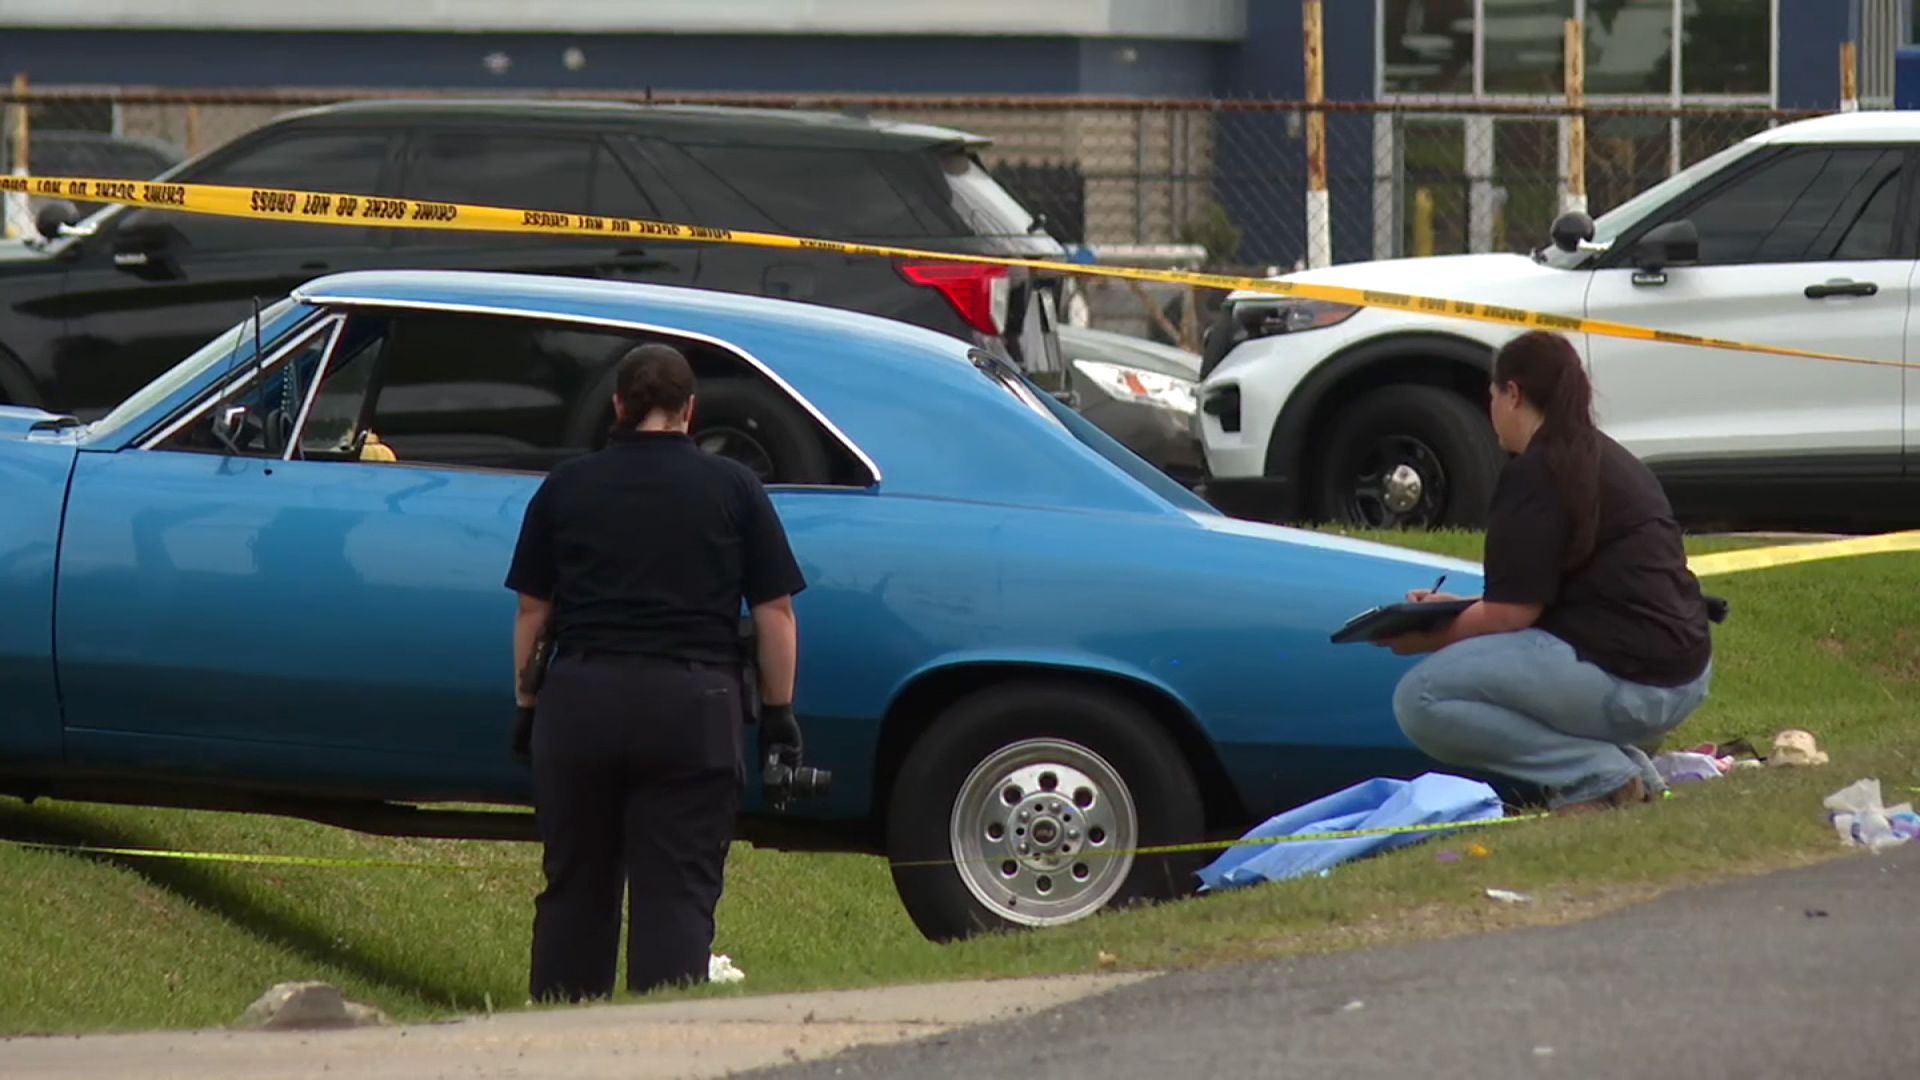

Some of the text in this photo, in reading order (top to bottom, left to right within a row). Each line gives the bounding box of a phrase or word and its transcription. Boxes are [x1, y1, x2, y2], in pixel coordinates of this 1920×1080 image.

[251, 190, 457, 222] CRIME SCENE DO NOT CROSS
